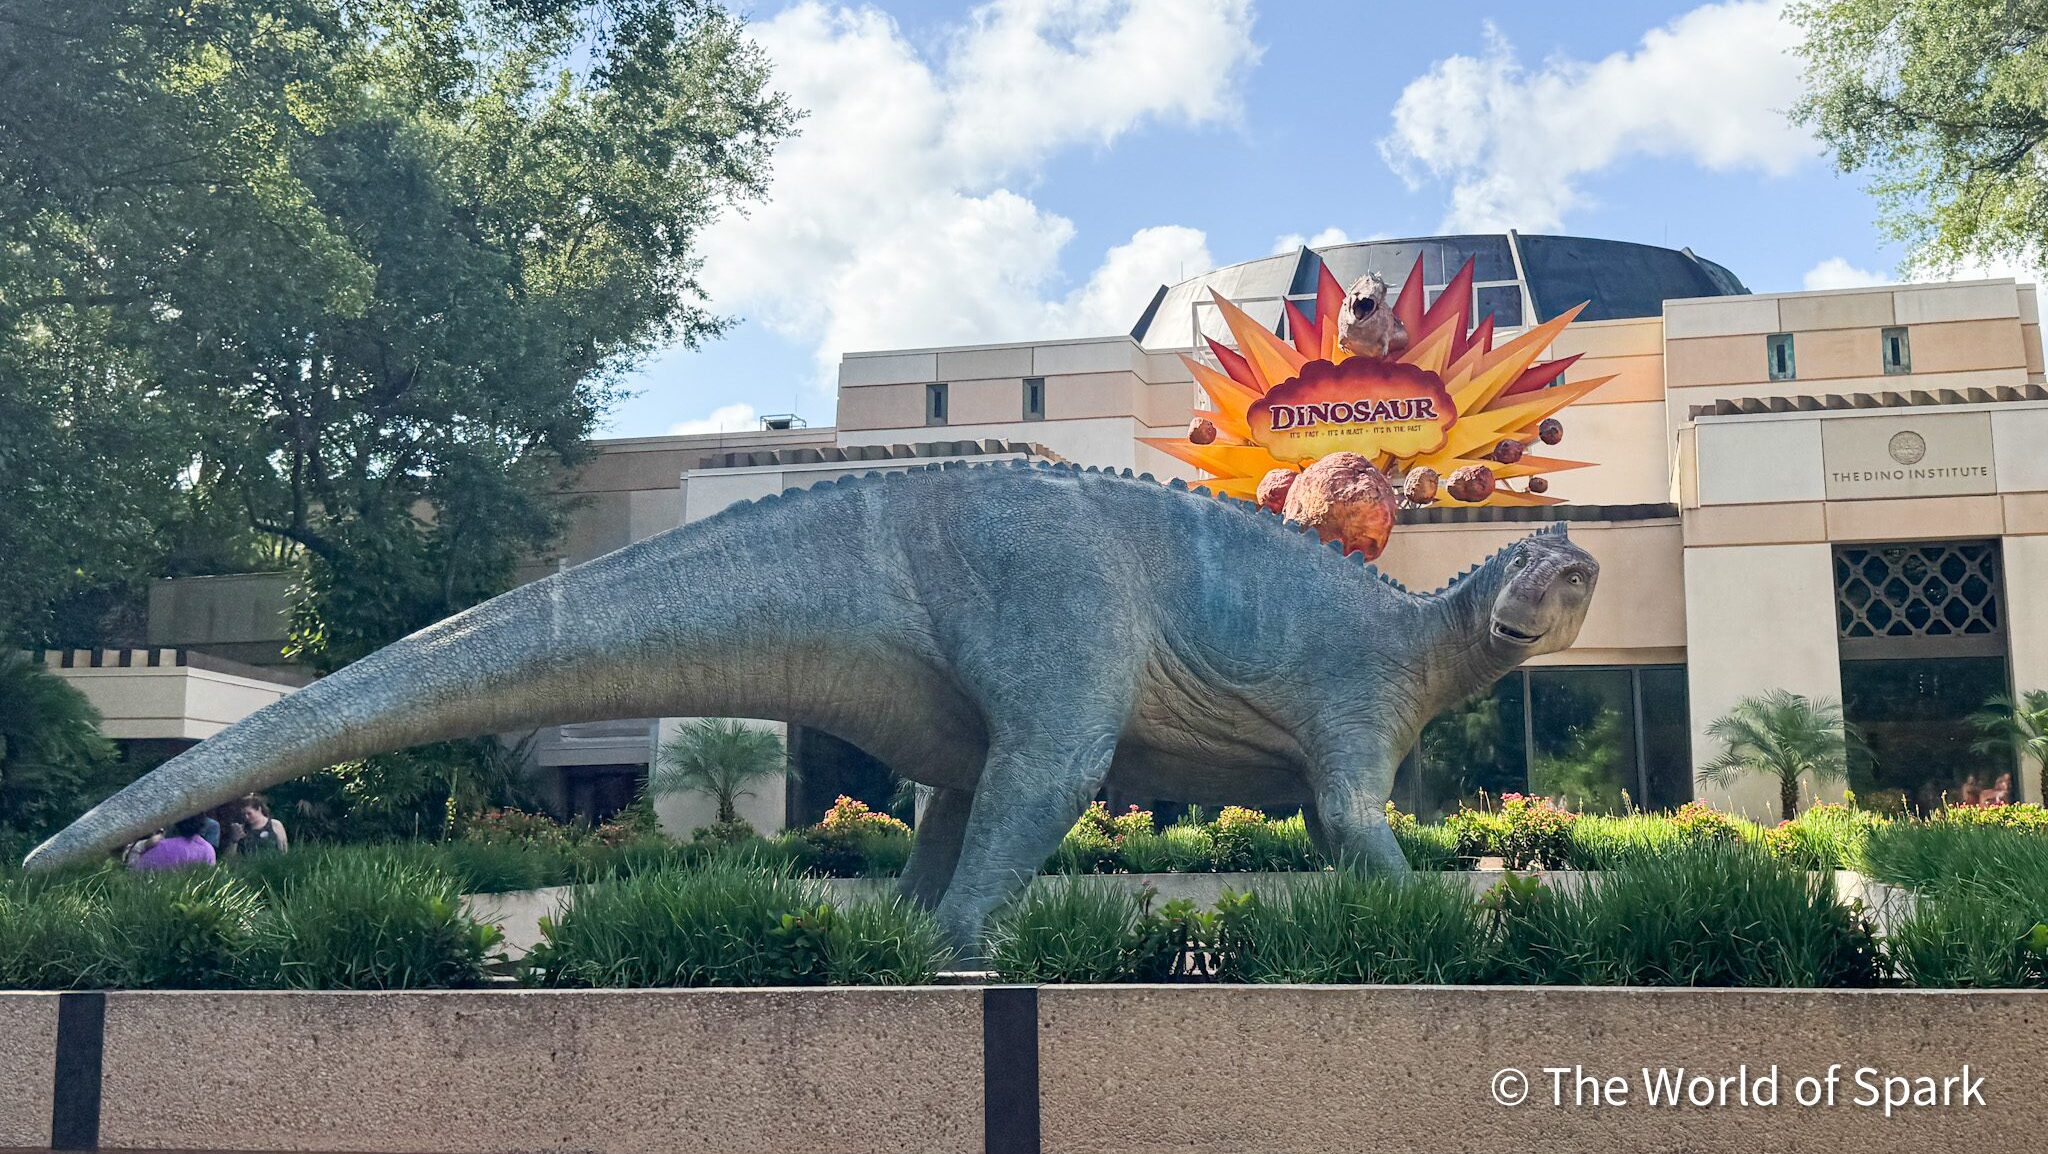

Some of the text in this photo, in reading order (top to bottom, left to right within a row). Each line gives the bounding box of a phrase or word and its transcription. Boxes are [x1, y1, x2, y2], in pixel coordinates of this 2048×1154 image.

[1270, 398, 1438, 430] DINOSAUR
[1832, 466, 1988, 482] THE DINO INSTITUTE
